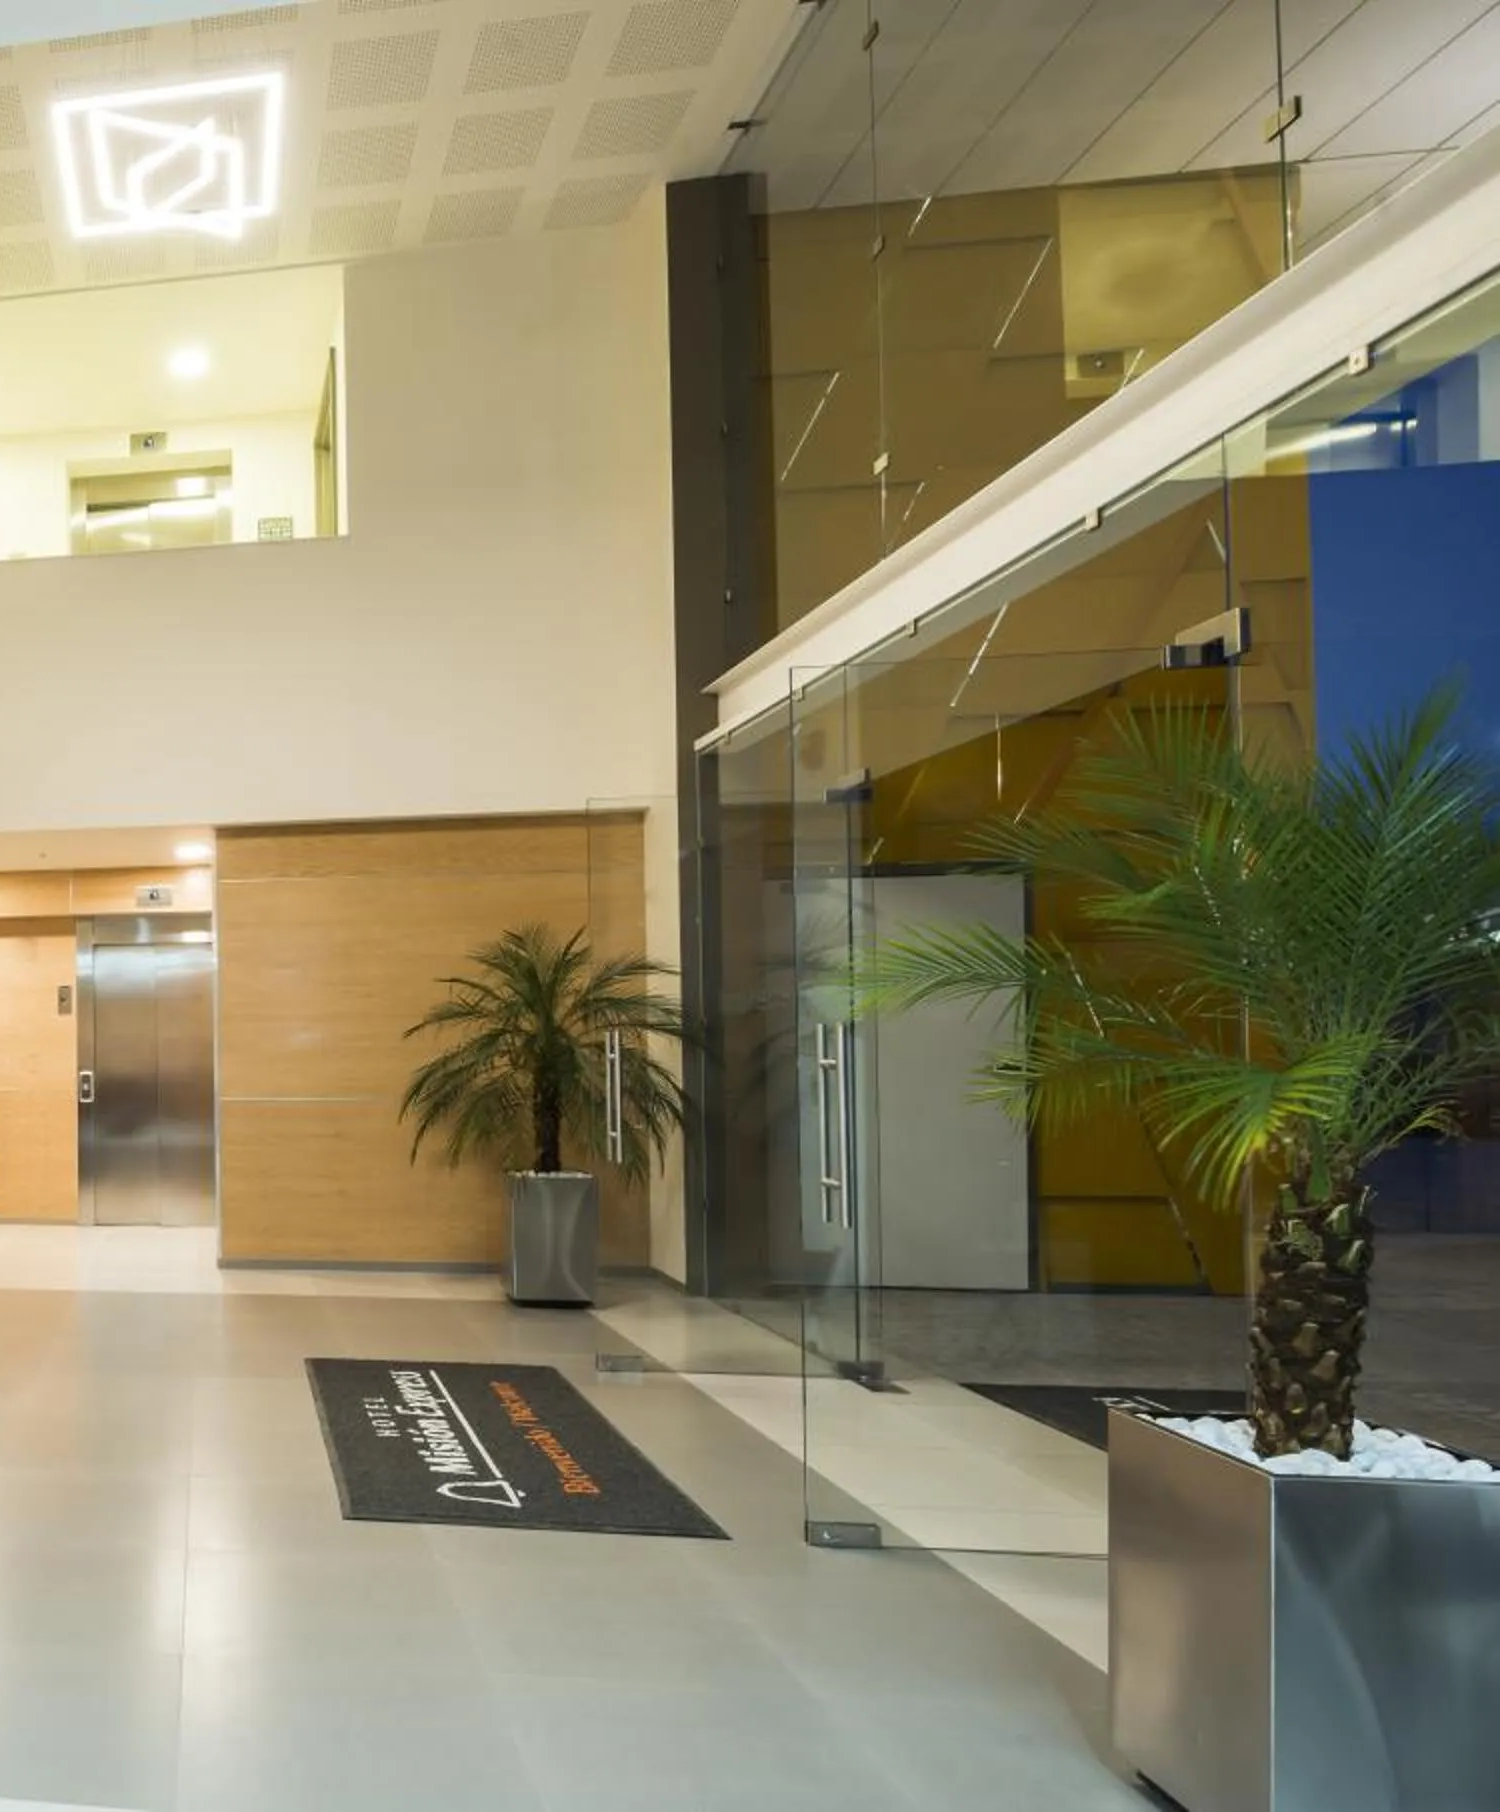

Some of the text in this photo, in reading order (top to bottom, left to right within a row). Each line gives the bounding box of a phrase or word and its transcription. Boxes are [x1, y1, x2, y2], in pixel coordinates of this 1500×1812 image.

[363, 1396, 401, 1437] HOTEL
[389, 1369, 478, 1476] Misión Express
